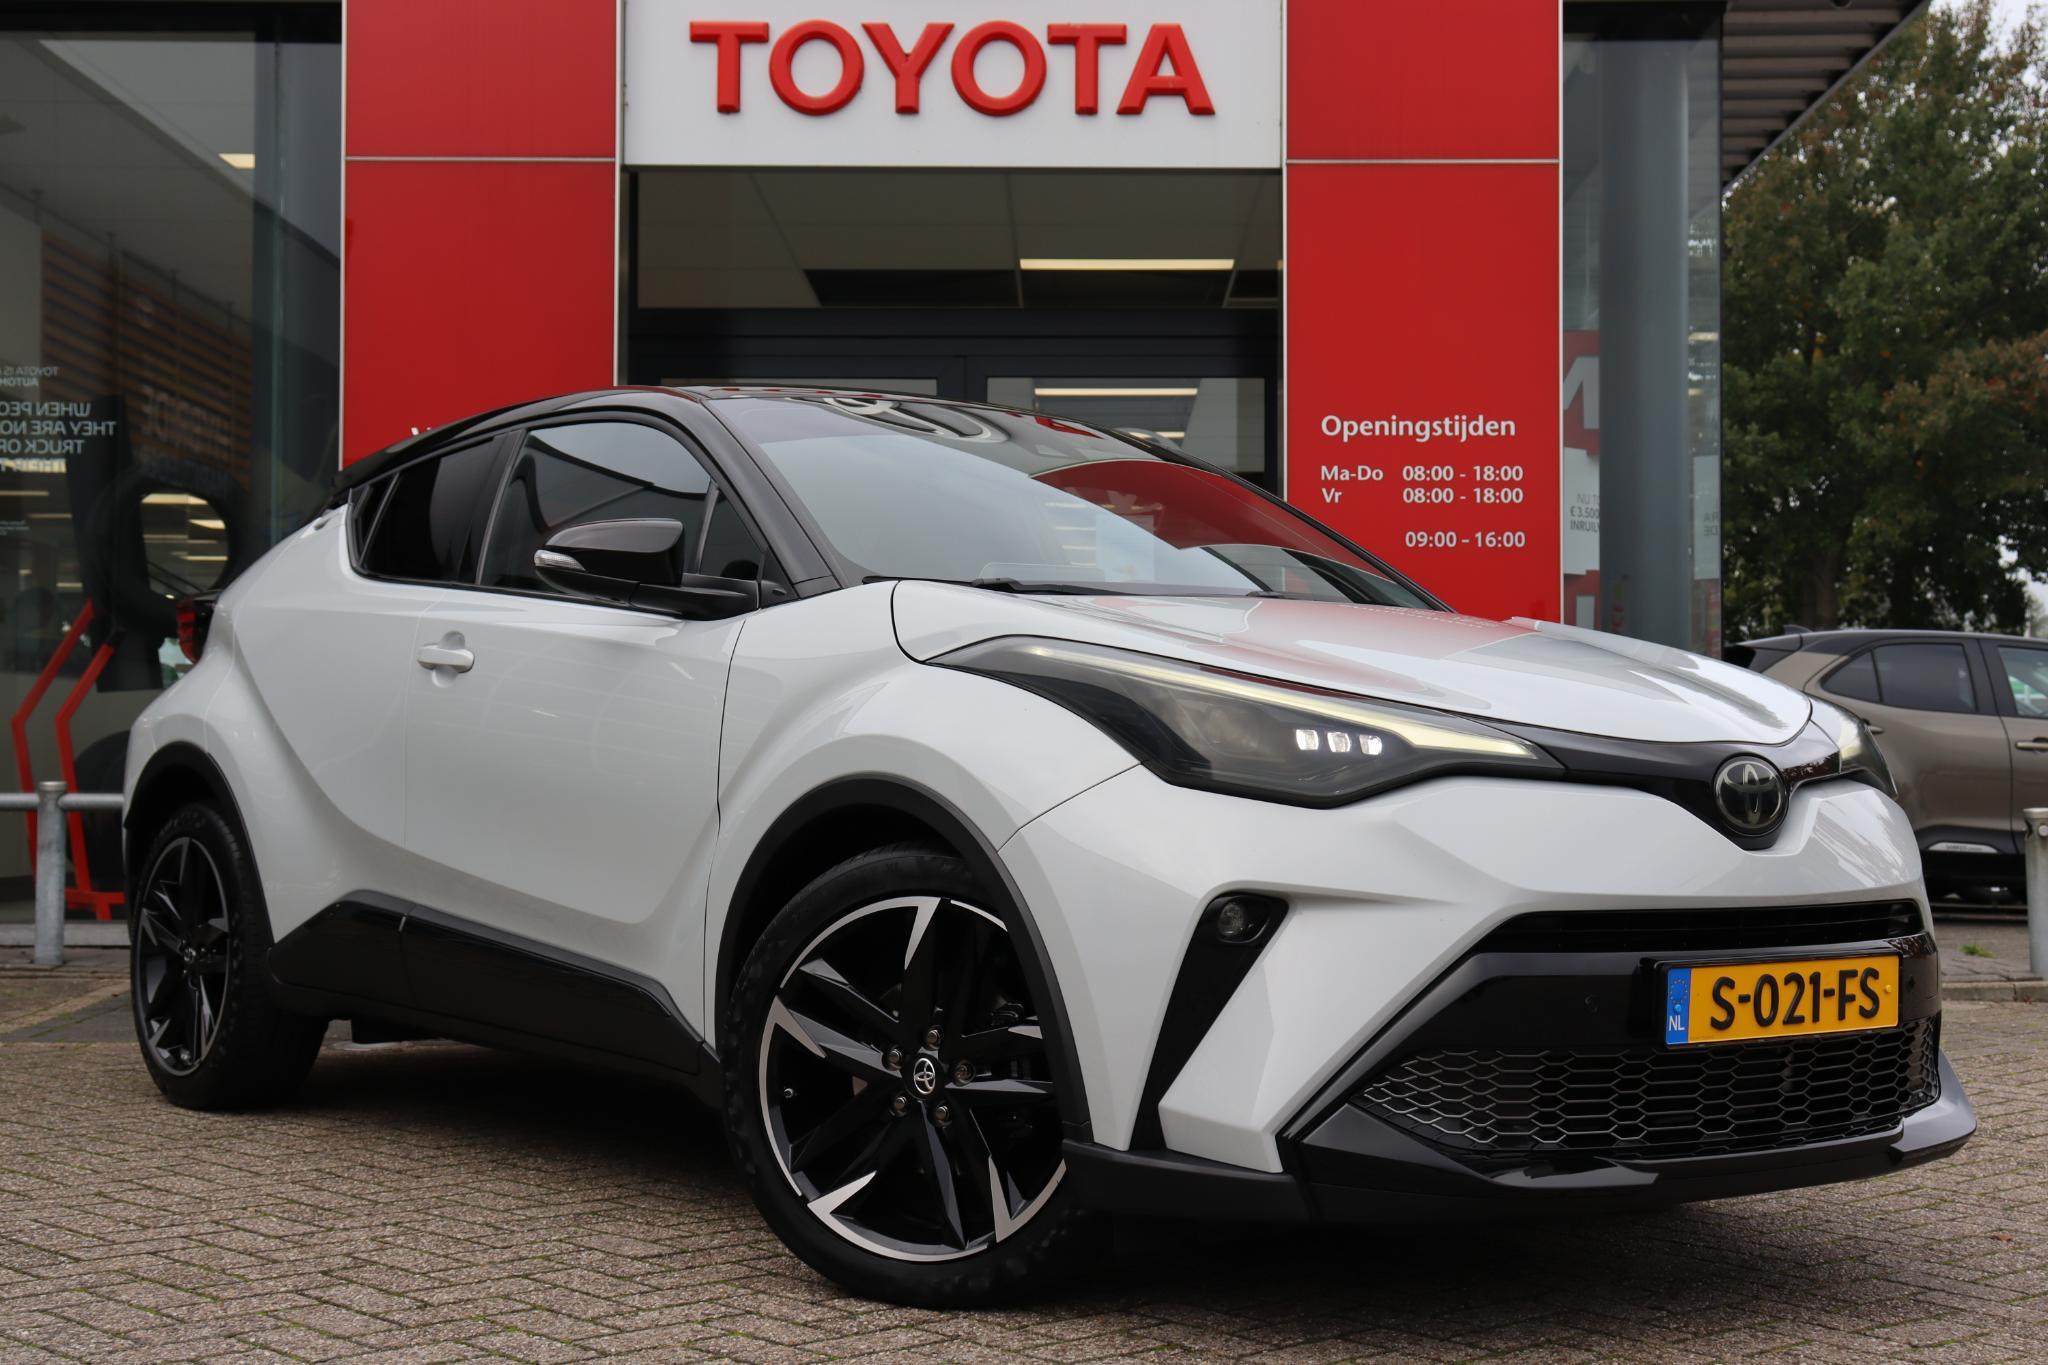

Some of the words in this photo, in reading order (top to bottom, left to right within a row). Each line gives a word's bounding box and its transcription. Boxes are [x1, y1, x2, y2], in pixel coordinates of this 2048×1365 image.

[689, 20, 1216, 117] TOYOTA
[1321, 415, 1517, 442] Openingstijden
[1320, 465, 1384, 481] Ma-Do
[1402, 465, 1454, 481] 08:00
[1473, 465, 1524, 481] 18:00
[1321, 488, 1343, 503] Vr
[1402, 488, 1454, 503] 08:00
[1473, 488, 1524, 503] 18:00
[1404, 531, 1457, 548] 09:00
[1474, 531, 1526, 548] 16:00
[1710, 967, 1880, 1031] S-021-FS
[1668, 1015, 1685, 1031] NL
